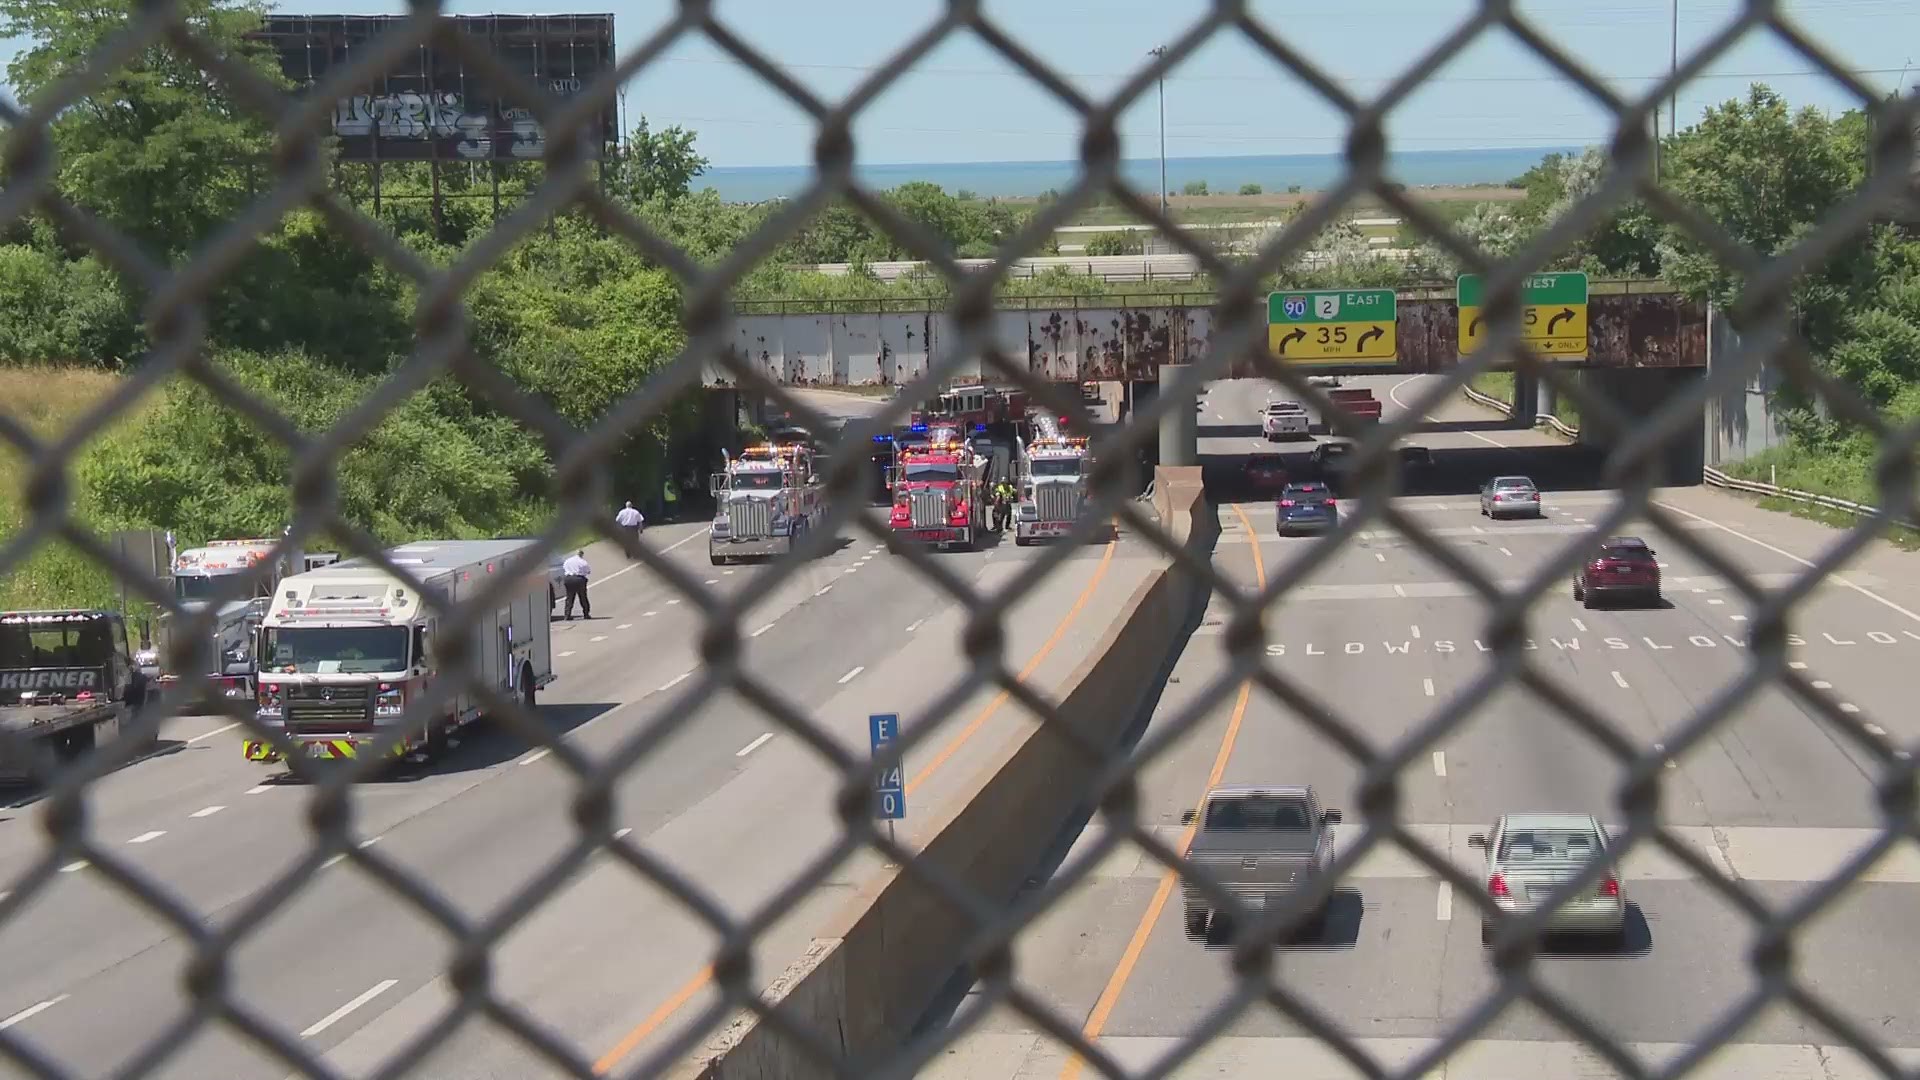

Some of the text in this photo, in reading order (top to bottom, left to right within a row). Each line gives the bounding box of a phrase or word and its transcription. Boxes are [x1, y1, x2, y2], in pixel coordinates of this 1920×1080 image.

[1521, 277, 1557, 288] WEST
[1285, 293, 1380, 315] 90 2 EAST
[1524, 308, 1538, 325] 5
[1317, 327, 1347, 344] 35
[1557, 341, 1580, 349] ONLY
[1265, 640, 1411, 656] SLOW
[0, 671, 96, 689] KUFNER
[878, 720, 889, 740] E
[883, 793, 895, 814] 0
